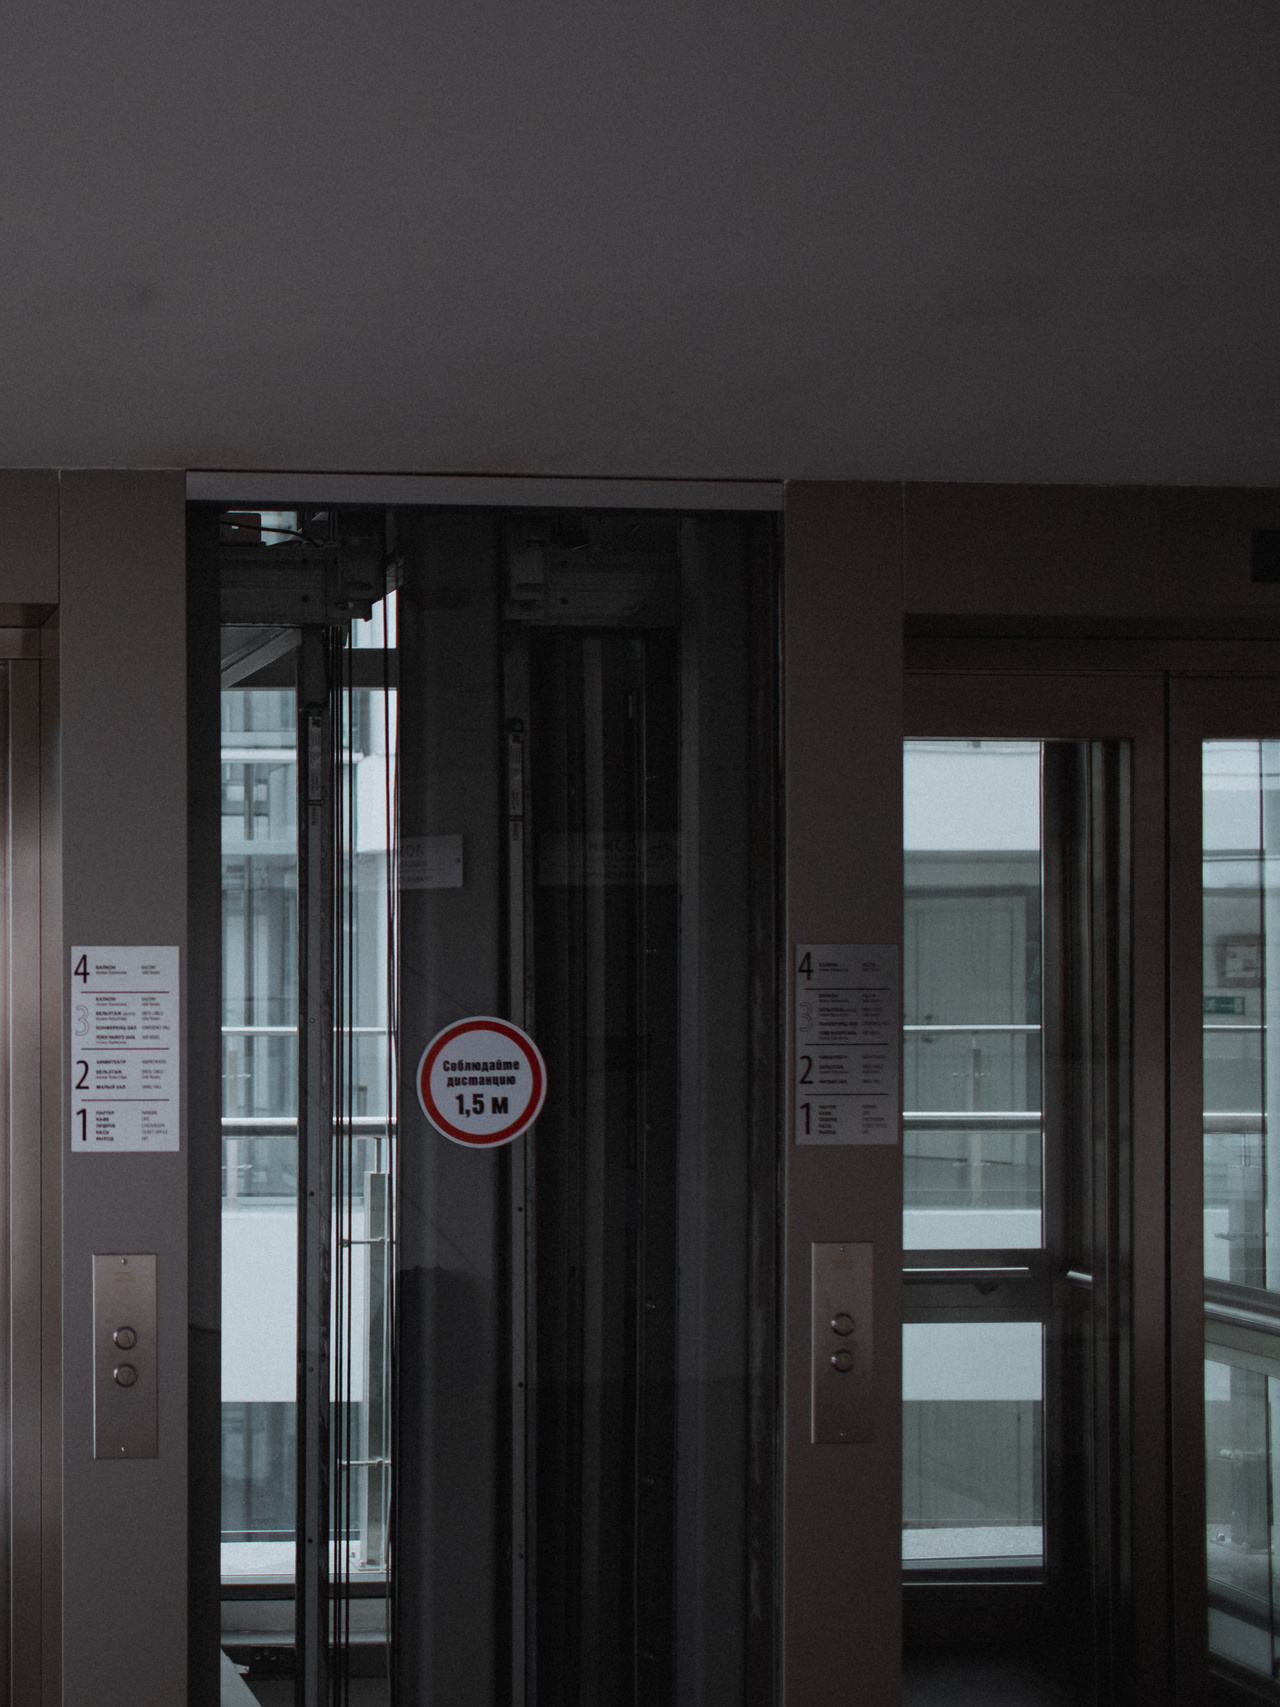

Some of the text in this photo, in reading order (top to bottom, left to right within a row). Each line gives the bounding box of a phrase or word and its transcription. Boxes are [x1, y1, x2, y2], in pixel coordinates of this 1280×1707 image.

[73, 953, 91, 984] 4
[797, 951, 814, 981] 4
[74, 1004, 91, 1037] 3
[798, 1001, 813, 1033] 3
[74, 1059, 90, 1090] 2
[442, 1059, 520, 1073] Соблюдайте
[446, 1075, 517, 1088] дистанцию
[799, 1054, 814, 1085] 2
[455, 1093, 485, 1118] 1,5
[799, 1102, 811, 1136] 1
[75, 1107, 87, 1142] 1
